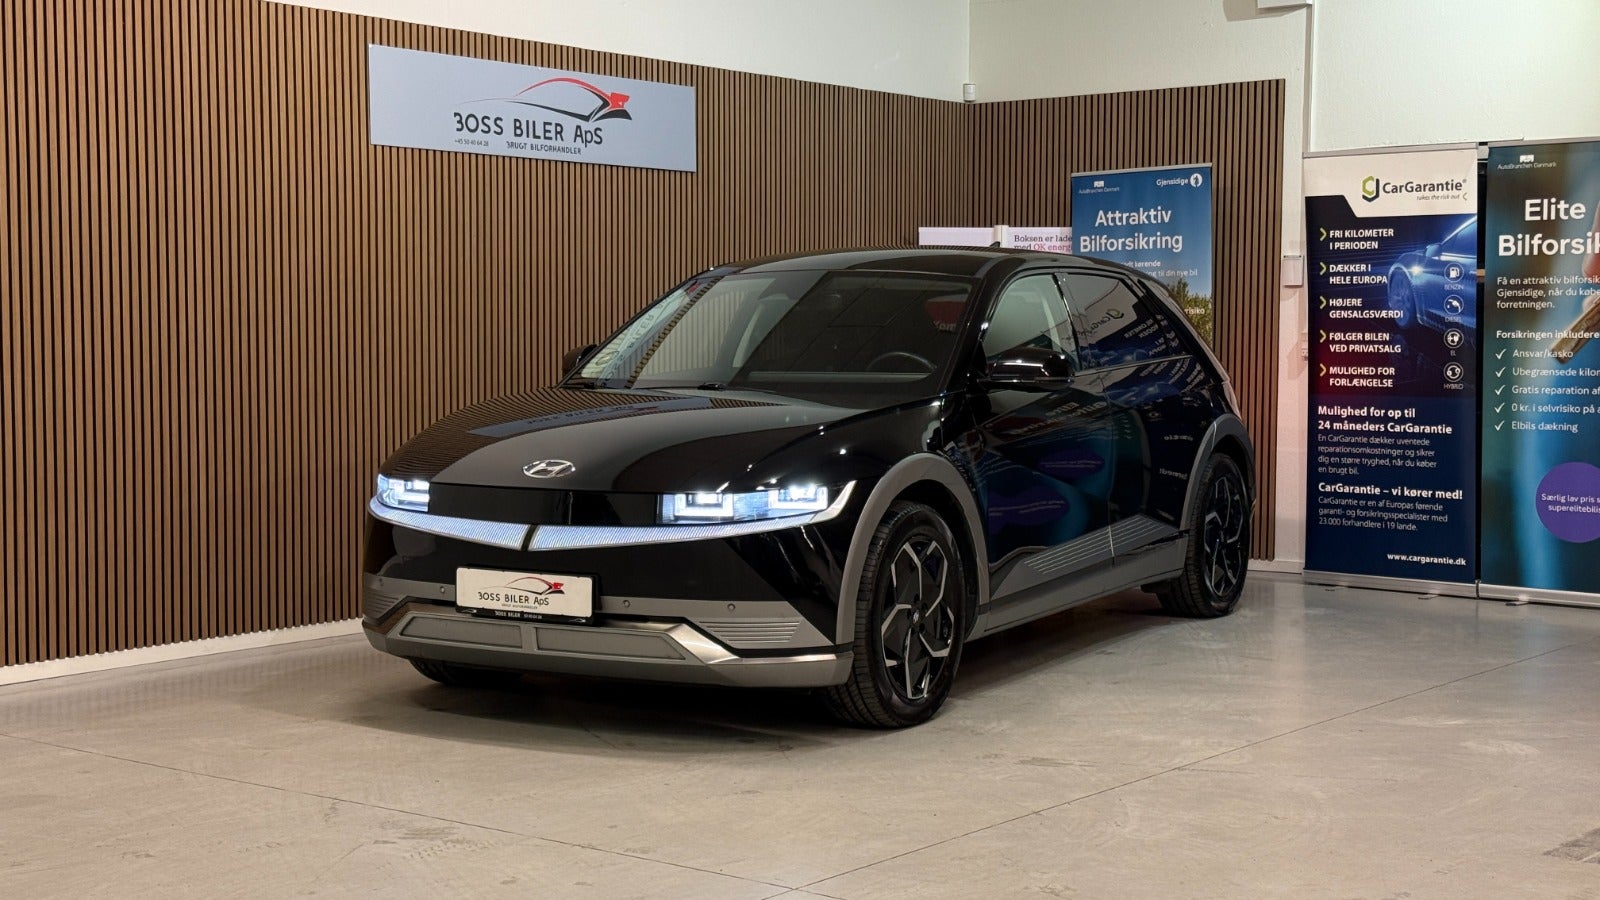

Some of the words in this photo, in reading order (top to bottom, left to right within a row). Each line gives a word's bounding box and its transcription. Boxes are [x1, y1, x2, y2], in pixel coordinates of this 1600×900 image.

[513, 118, 564, 142] BILER
[573, 124, 603, 148] ApS
[530, 143, 582, 155] BILFORHANDLER
[1156, 178, 1188, 188] Gjensidige
[1524, 198, 1586, 221] Elite
[1095, 206, 1172, 227] Attraktiv
[1330, 230, 1343, 239] FRI
[1344, 228, 1394, 238] KILOMETER
[1080, 232, 1183, 252] Bilforsikring
[1330, 242, 1333, 250] I
[1335, 241, 1378, 250] PERIODEN
[1176, 270, 1188, 278] nye
[1330, 264, 1367, 273] DÆKKER
[1368, 264, 1371, 272] I
[1330, 276, 1351, 284] HELE
[1352, 275, 1388, 284] EUROPA
[1497, 277, 1507, 285] Få
[1523, 276, 1561, 285] attraktiv
[1497, 288, 1546, 298] Gjensidige,
[1548, 288, 1563, 296] når
[1566, 288, 1576, 296] du
[1329, 298, 1362, 307] HØJERE
[1496, 301, 1555, 310] forretningen.
[1329, 310, 1404, 319] GENSALGSVÆRDI
[1329, 332, 1363, 341] FØLGER
[1365, 332, 1389, 341] BILEN
[1496, 330, 1552, 340] Forsikringen
[1329, 344, 1347, 352] VED
[1349, 344, 1401, 353] PRIVATSALG
[1513, 349, 1573, 358] Ansvar/kasko
[1329, 367, 1376, 375] MULIGHED
[1378, 367, 1395, 375] FOR
[1512, 367, 1576, 377] Ubegrænsede
[1329, 378, 1393, 387] FORLÆNGELSE
[1512, 385, 1539, 394] Gratis
[1541, 386, 1589, 396] reparation
[1318, 406, 1367, 418] Mulighed
[1370, 407, 1385, 417] for
[1388, 410, 1402, 419] op
[1404, 408, 1415, 418] til
[1512, 403, 1517, 412] 0
[1520, 403, 1531, 412] kr.
[1537, 404, 1581, 413] selvrisiko
[1583, 405, 1594, 415] på
[1318, 421, 1330, 430] 24
[1333, 421, 1385, 432] måneders
[1387, 422, 1452, 434] CarGarantie
[1512, 421, 1535, 430] Elbils
[1538, 422, 1578, 433] dækning
[1318, 434, 1326, 442] En
[1328, 434, 1368, 443] CarGarantie
[1369, 436, 1395, 444] dækker
[1396, 437, 1430, 446] uventede
[1318, 446, 1404, 456] reparationsomkostninger
[1405, 449, 1414, 457] og
[1318, 456, 1329, 464] dig
[1362, 458, 1390, 467] tryghed,
[1405, 459, 1414, 467] du
[1416, 460, 1437, 468] køber
[1328, 466, 1347, 475] brugt
[1349, 467, 1359, 475] bil.
[1318, 482, 1380, 495] CarGarantie
[1392, 486, 1401, 496] vi
[1404, 487, 1432, 498] kører
[1435, 490, 1463, 499] med!
[1318, 497, 1357, 506] CarGarantie
[1386, 501, 1414, 510] Europas
[1415, 502, 1443, 511] førende
[1541, 493, 1566, 502] Særlig
[1567, 494, 1578, 502] lav
[1580, 495, 1594, 504] pris
[1318, 507, 1344, 516] garanti-
[1356, 509, 1429, 521] forsikringsspecialister
[1342, 518, 1382, 529] forhandlere
[1396, 522, 1418, 531] lande.
[1387, 552, 1466, 566] www.cargarantie.dk
[505, 594, 529, 604] BILER
[534, 596, 550, 607] ApS
